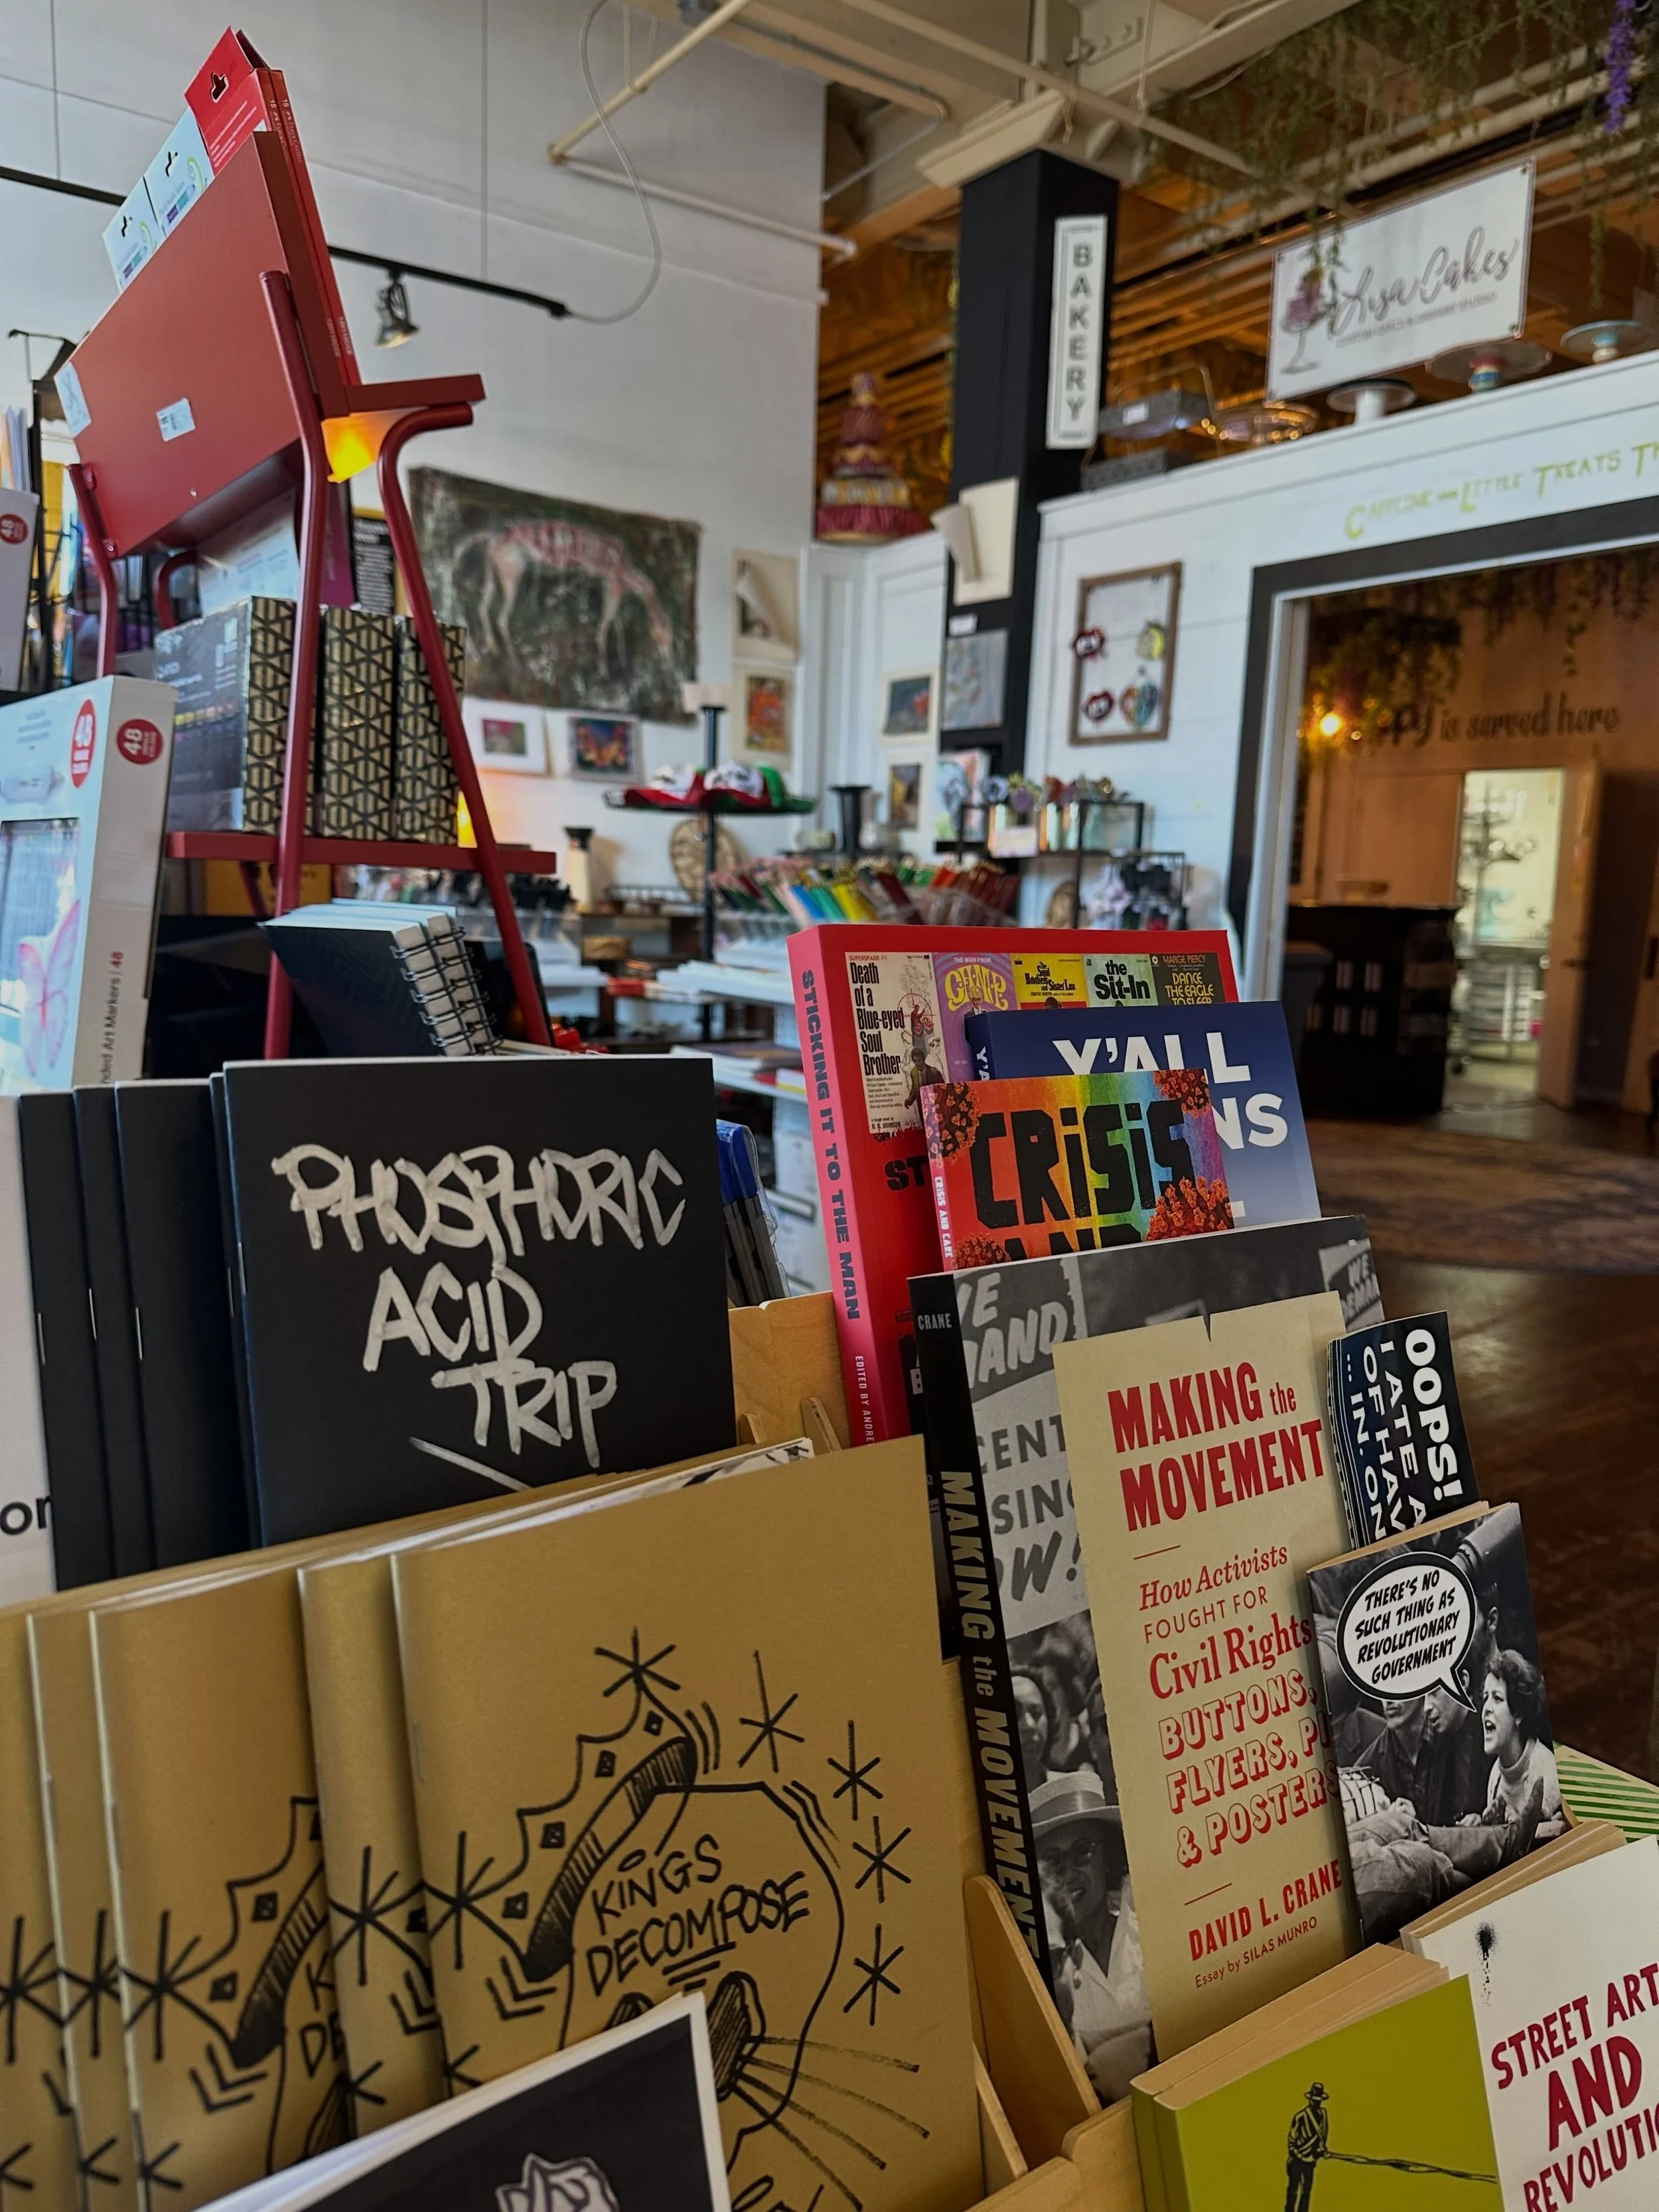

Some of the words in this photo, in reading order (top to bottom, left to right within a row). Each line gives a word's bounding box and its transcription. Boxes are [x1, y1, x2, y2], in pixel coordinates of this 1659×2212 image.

[1066, 243, 1094, 422] BAKERY
[124, 728, 142, 756] 48
[850, 962, 880, 984] Death
[1037, 965, 1051, 978] Soul
[1105, 960, 1127, 976] the
[1163, 955, 1186, 964] MARGE
[1187, 954, 1206, 964] PIERCY
[1172, 972, 1203, 986] DANCE
[854, 985, 865, 1007] of
[867, 988, 874, 1007] a
[1094, 974, 1151, 1001] Sit-In
[1165, 985, 1185, 998] THE
[1185, 984, 1215, 997] EAGLE
[802, 970, 830, 1101] STICKING
[856, 1007, 905, 1031] Blue-eyed
[860, 1031, 883, 1053] Soul
[863, 1053, 901, 1076] Brother
[820, 1108, 835, 1134] IT
[824, 1143, 841, 1181] TO
[270, 1143, 687, 1263] PHOSPHORIC
[831, 1189, 850, 1244] THE
[942, 1232, 954, 1258] CARE
[839, 1252, 860, 1320] MAN
[362, 1262, 543, 1372] ACID
[918, 1313, 953, 1331] CRANE
[855, 1355, 867, 1389] EDITED
[1380, 1341, 1395, 1353] I
[860, 1393, 869, 1406] BY
[1108, 1362, 1263, 1453] MAKING
[1269, 1382, 1297, 1416] the
[1362, 1345, 1386, 1418] OF
[431, 1357, 618, 1468] TRIP
[1385, 1370, 1419, 1479] ATE
[1406, 1328, 1464, 1502] OOPS!
[1119, 1419, 1325, 1532] MOVEMENT
[940, 1469, 996, 1643] MAKING
[972, 1655, 994, 1698] the
[1139, 1576, 1192, 1611] How
[1195, 1545, 1288, 1595] Activists
[1364, 1576, 1418, 1612] THERE'S
[1421, 1570, 1440, 1591] NO
[1144, 1600, 1226, 1643] FOUGHT
[1233, 1585, 1268, 1614] FOR
[1354, 1610, 1392, 1641] SUCH
[1396, 1595, 1435, 1627] THING
[1438, 1587, 1456, 1611] AS
[1357, 1609, 1461, 1665] REVOLUTIONARY
[1149, 1635, 1223, 1700] Civil
[1223, 1611, 1313, 1670] Rights
[1371, 1635, 1457, 1685] GOVERNMENT
[1158, 1668, 1318, 1760] BUTTONS,
[1176, 1825, 1202, 1868] &
[1205, 1759, 1340, 1856] POSTERS
[592, 1834, 722, 1936] KINGS
[1188, 1905, 1252, 1962] DAVID
[1259, 1897, 1279, 1927] L.
[1283, 1858, 1344, 1915] CRANE
[586, 1871, 810, 1997] DECOMPOSE
[1195, 1966, 1226, 1990] Essay
[1226, 1950, 1241, 1974] by
[1243, 1938, 1275, 1966] SILAS
[1277, 1915, 1318, 1949] MUNRO
[1490, 1994, 1593, 2090] STREET
[1607, 1962, 1659, 2029] ART
[1548, 2035, 1643, 2152] AND
